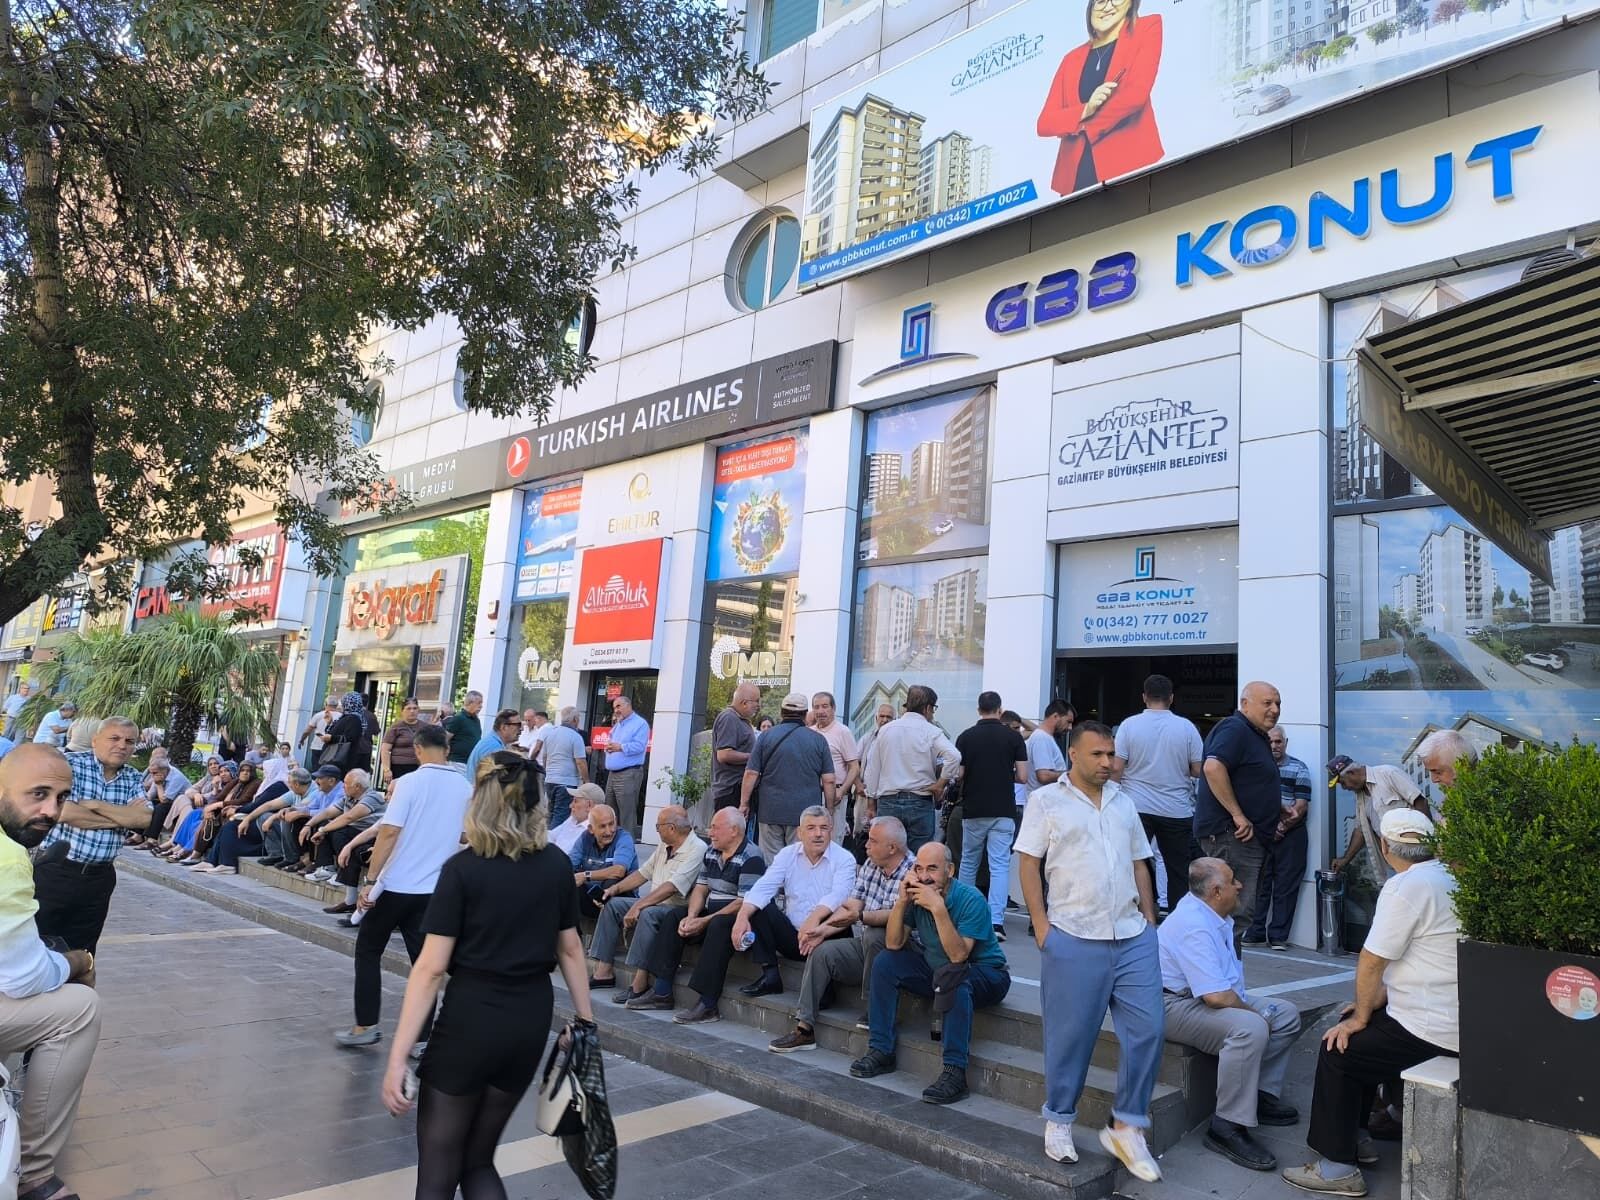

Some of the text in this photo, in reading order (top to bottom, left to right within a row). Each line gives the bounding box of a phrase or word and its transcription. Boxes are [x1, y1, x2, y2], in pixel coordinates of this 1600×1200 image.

[818, 229, 919, 273] www.gbbkonut.com.tr
[974, 198, 994, 215] 777
[998, 186, 1028, 206] 0027
[985, 124, 1546, 336] GBB KONUT
[772, 398, 790, 409] SALES
[537, 378, 744, 458] TURKISH AIRLINES
[1058, 416, 1228, 468] GAZİANTEP
[423, 459, 456, 480] MEDYA
[1057, 449, 1228, 486] GAZİANTEP BÜYÜKŞEHİR BELEDİYESİ
[420, 479, 453, 498] GRUBU
[1096, 587, 1195, 603] GBB KONUT
[1096, 612, 1209, 629] 0(342) 777 0027
[1096, 629, 1208, 644] www.gbbkonut.com.tr
[721, 650, 791, 678] UMRE
